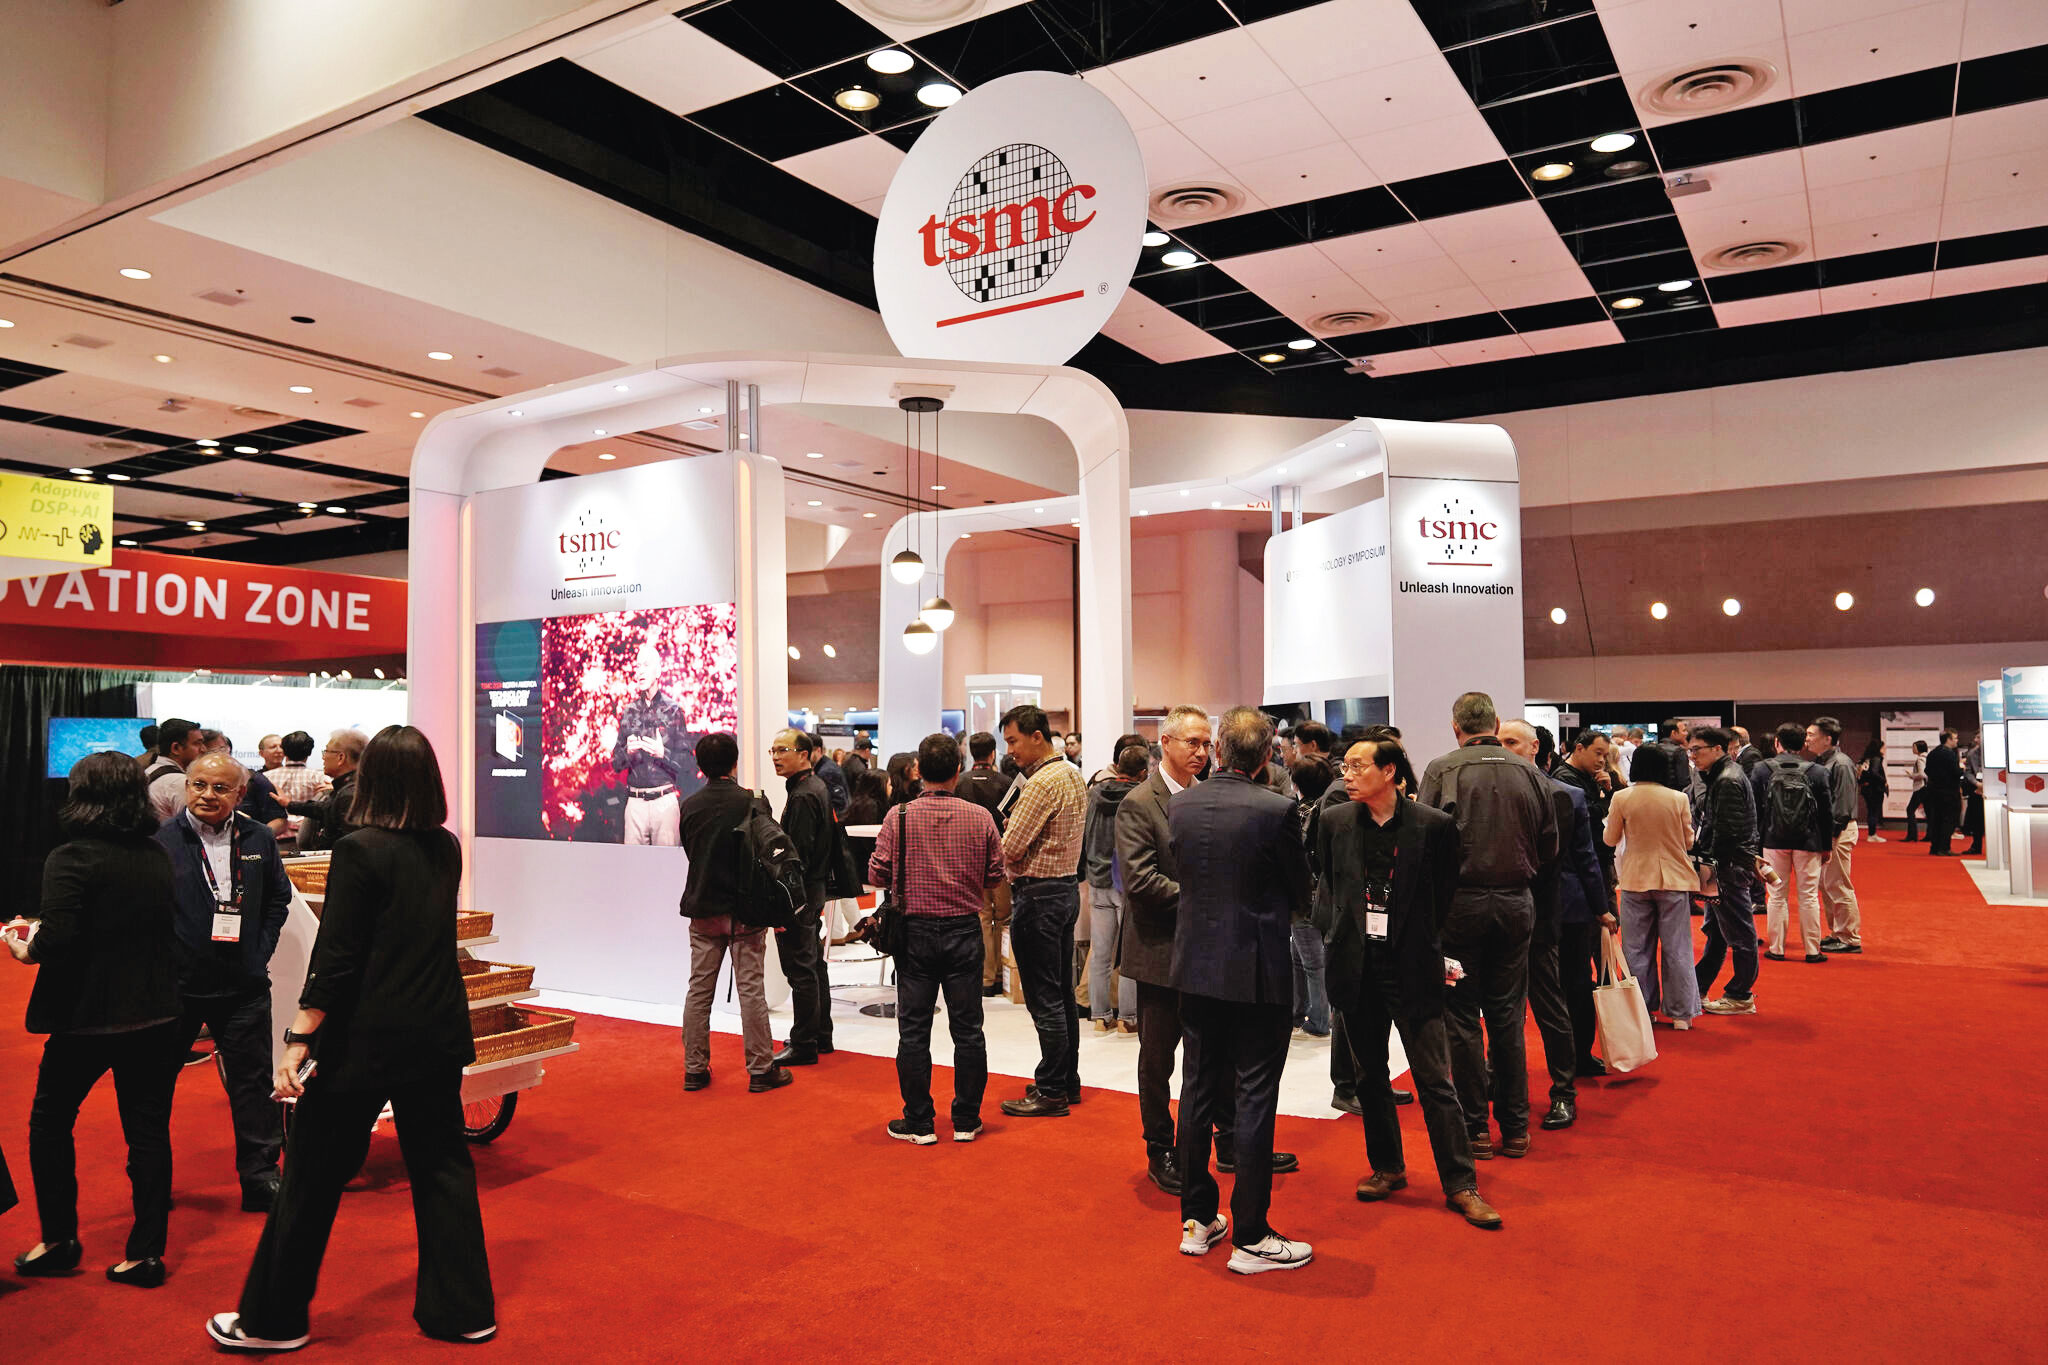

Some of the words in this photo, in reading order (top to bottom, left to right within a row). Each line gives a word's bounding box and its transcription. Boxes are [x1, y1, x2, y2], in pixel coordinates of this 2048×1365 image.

[918, 184, 1097, 267] tsmc
[30, 481, 100, 500] Adaptive
[31, 498, 99, 519] DSP+AI
[1417, 516, 1498, 541] tsmc
[558, 530, 621, 554] tsmc
[1347, 545, 1386, 566] SYMPOSIUM
[551, 587, 588, 601] Unleash
[590, 583, 642, 598] Innovation
[1399, 581, 1449, 594] Unleash
[1452, 582, 1514, 595] Innovation
[0, 568, 228, 621] VATION
[245, 582, 371, 632] ZONE
